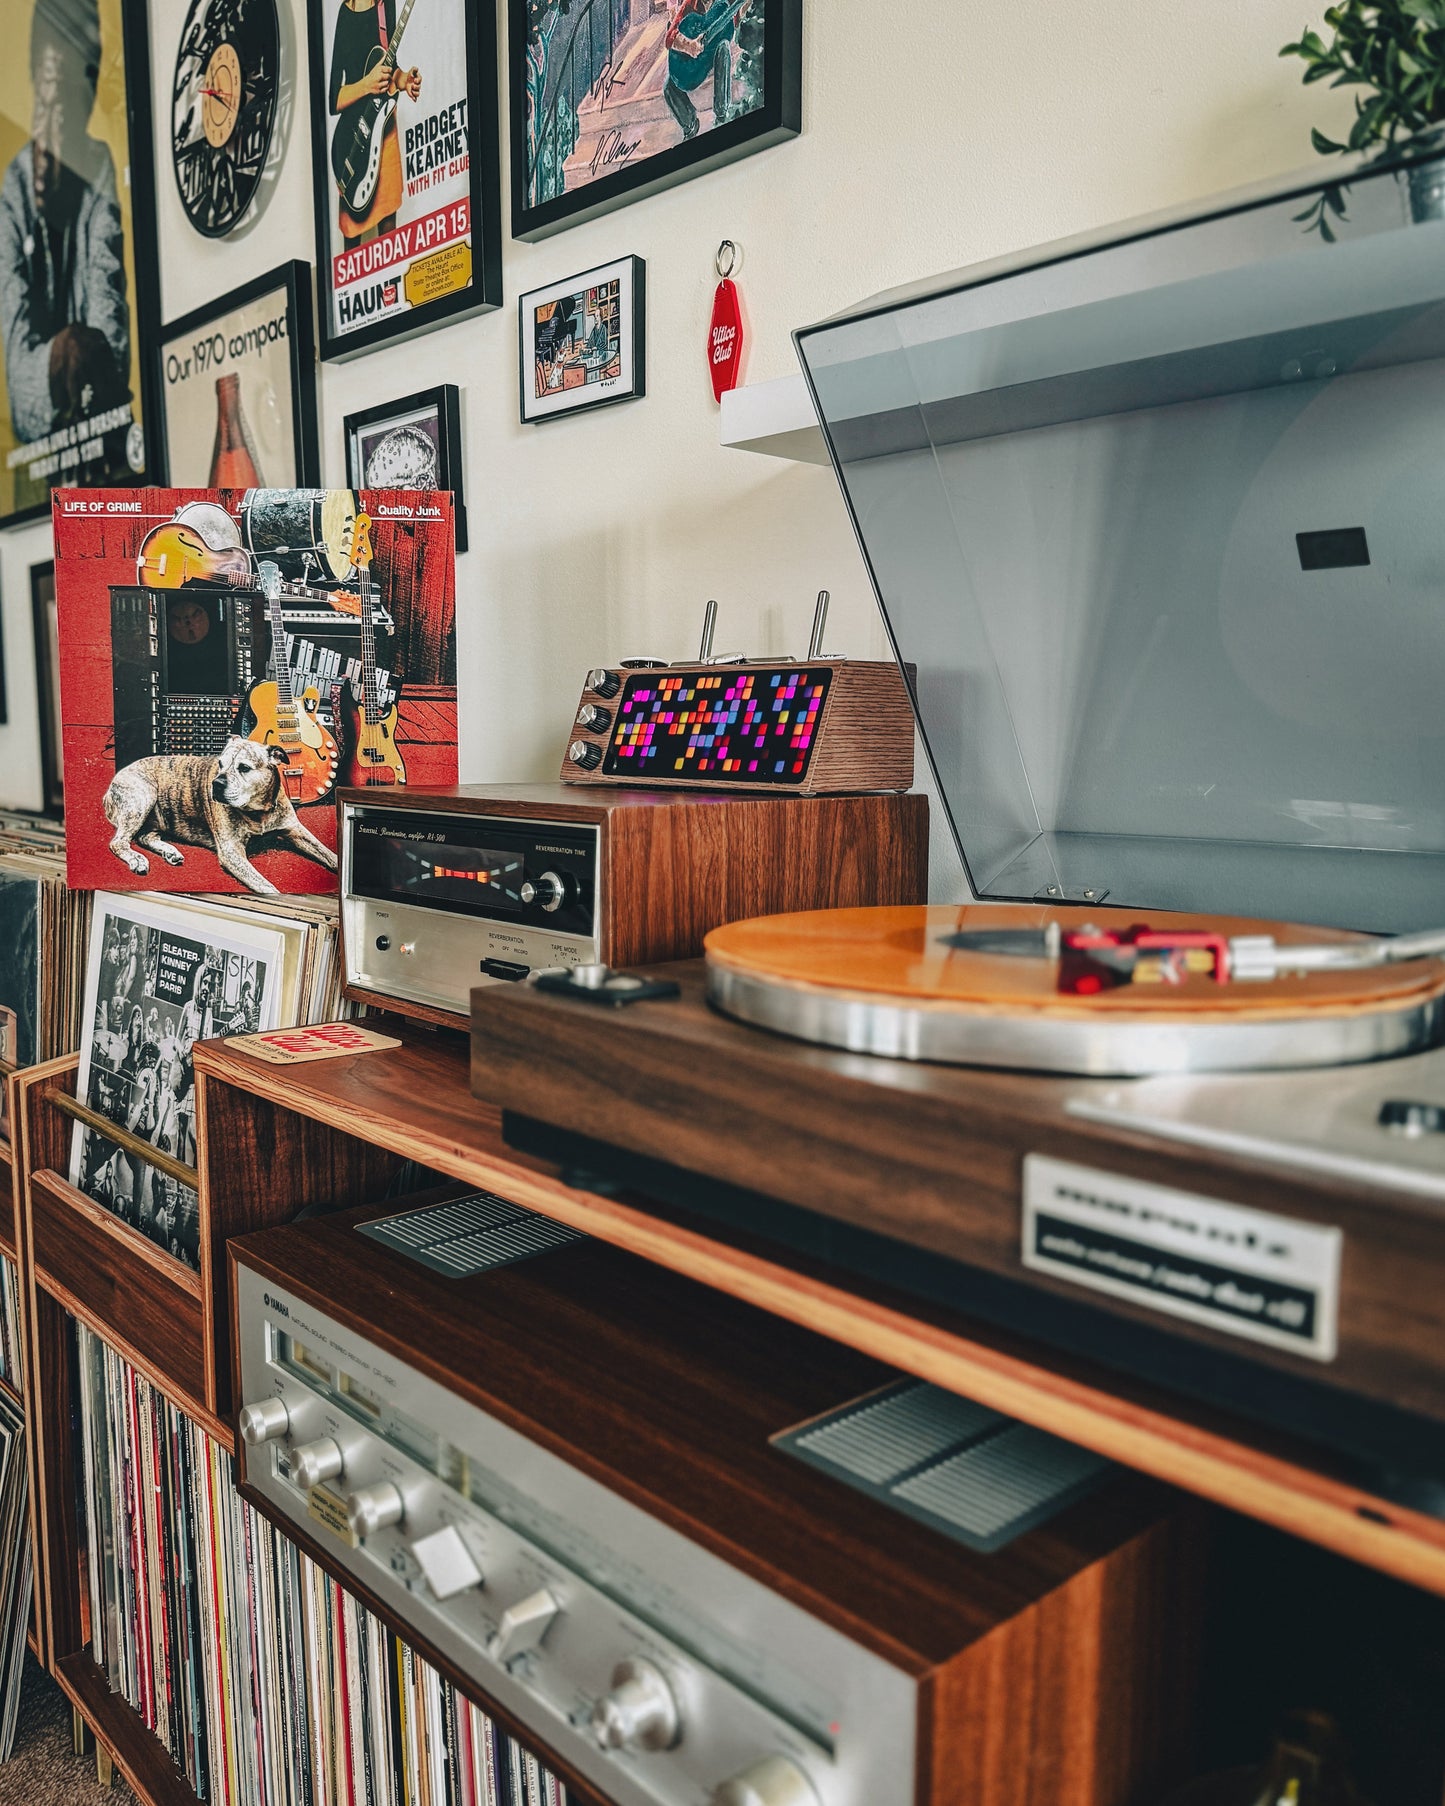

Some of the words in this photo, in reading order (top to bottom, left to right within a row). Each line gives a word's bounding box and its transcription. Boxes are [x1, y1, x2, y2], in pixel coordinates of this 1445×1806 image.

[405, 98, 467, 154] BRIDGET
[407, 174, 430, 197] WITH
[432, 166, 446, 186] FIT
[337, 228, 412, 284] SATURDAY
[415, 213, 447, 251] APR
[450, 204, 467, 235] 15
[338, 290, 349, 299] THE
[338, 275, 402, 326] HAUNT
[712, 325, 736, 346] Utica
[167, 355, 191, 384] Our
[193, 333, 225, 374] 1970
[713, 341, 733, 365] Club
[64, 501, 87, 512] LIFE
[89, 502, 104, 512] OF
[106, 502, 142, 512] GRIME
[378, 504, 414, 518] Quality
[416, 506, 441, 516] Junk
[535, 844, 573, 855] REVERBERATION
[574, 849, 586, 857] TIME
[488, 932, 524, 944] REVERBERATION
[162, 943, 201, 962] SLEATER-
[551, 944, 563, 952] TAPE
[563, 946, 578, 955] MODE
[160, 954, 192, 972] KINNEY
[160, 969, 177, 982] LIVE
[177, 975, 187, 985] IN
[159, 980, 183, 995] PARIS
[270, 1296, 290, 1318] YAMAHA
